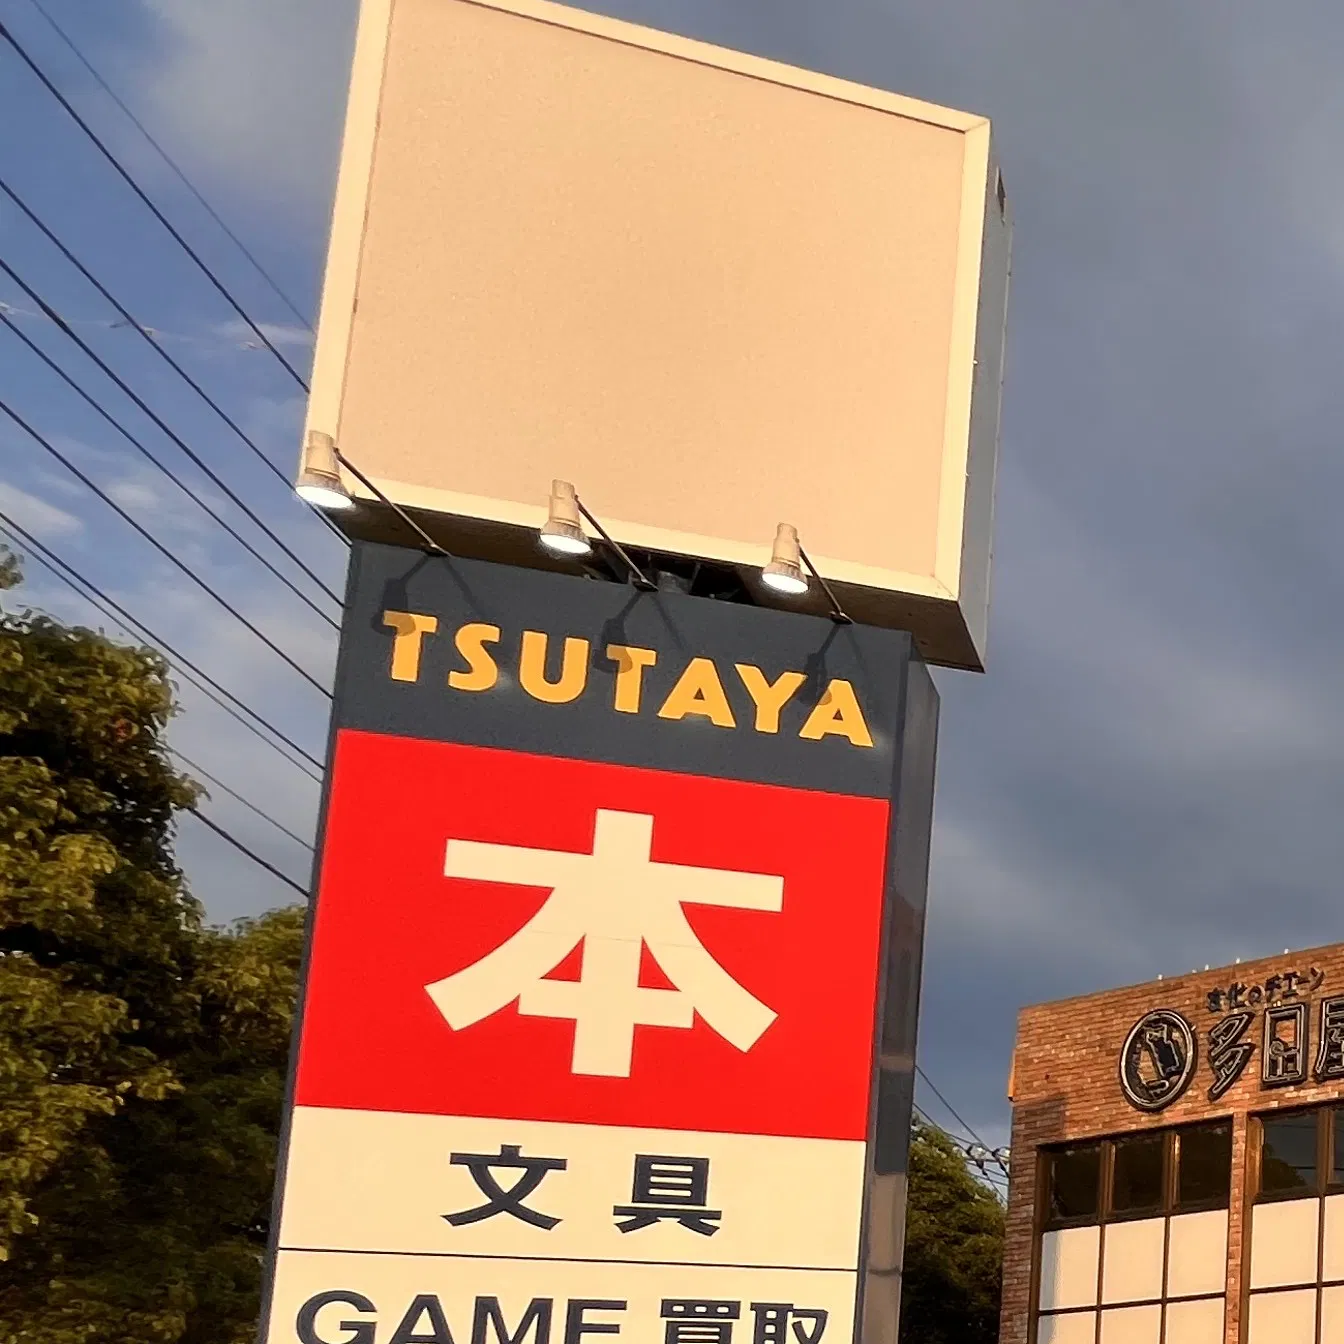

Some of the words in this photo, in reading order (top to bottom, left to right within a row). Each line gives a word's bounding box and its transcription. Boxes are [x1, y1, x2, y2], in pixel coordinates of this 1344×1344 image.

[382, 609, 873, 748] TSUTAYA
[424, 807, 784, 1078] 本
[442, 1143, 723, 1237] 文具
